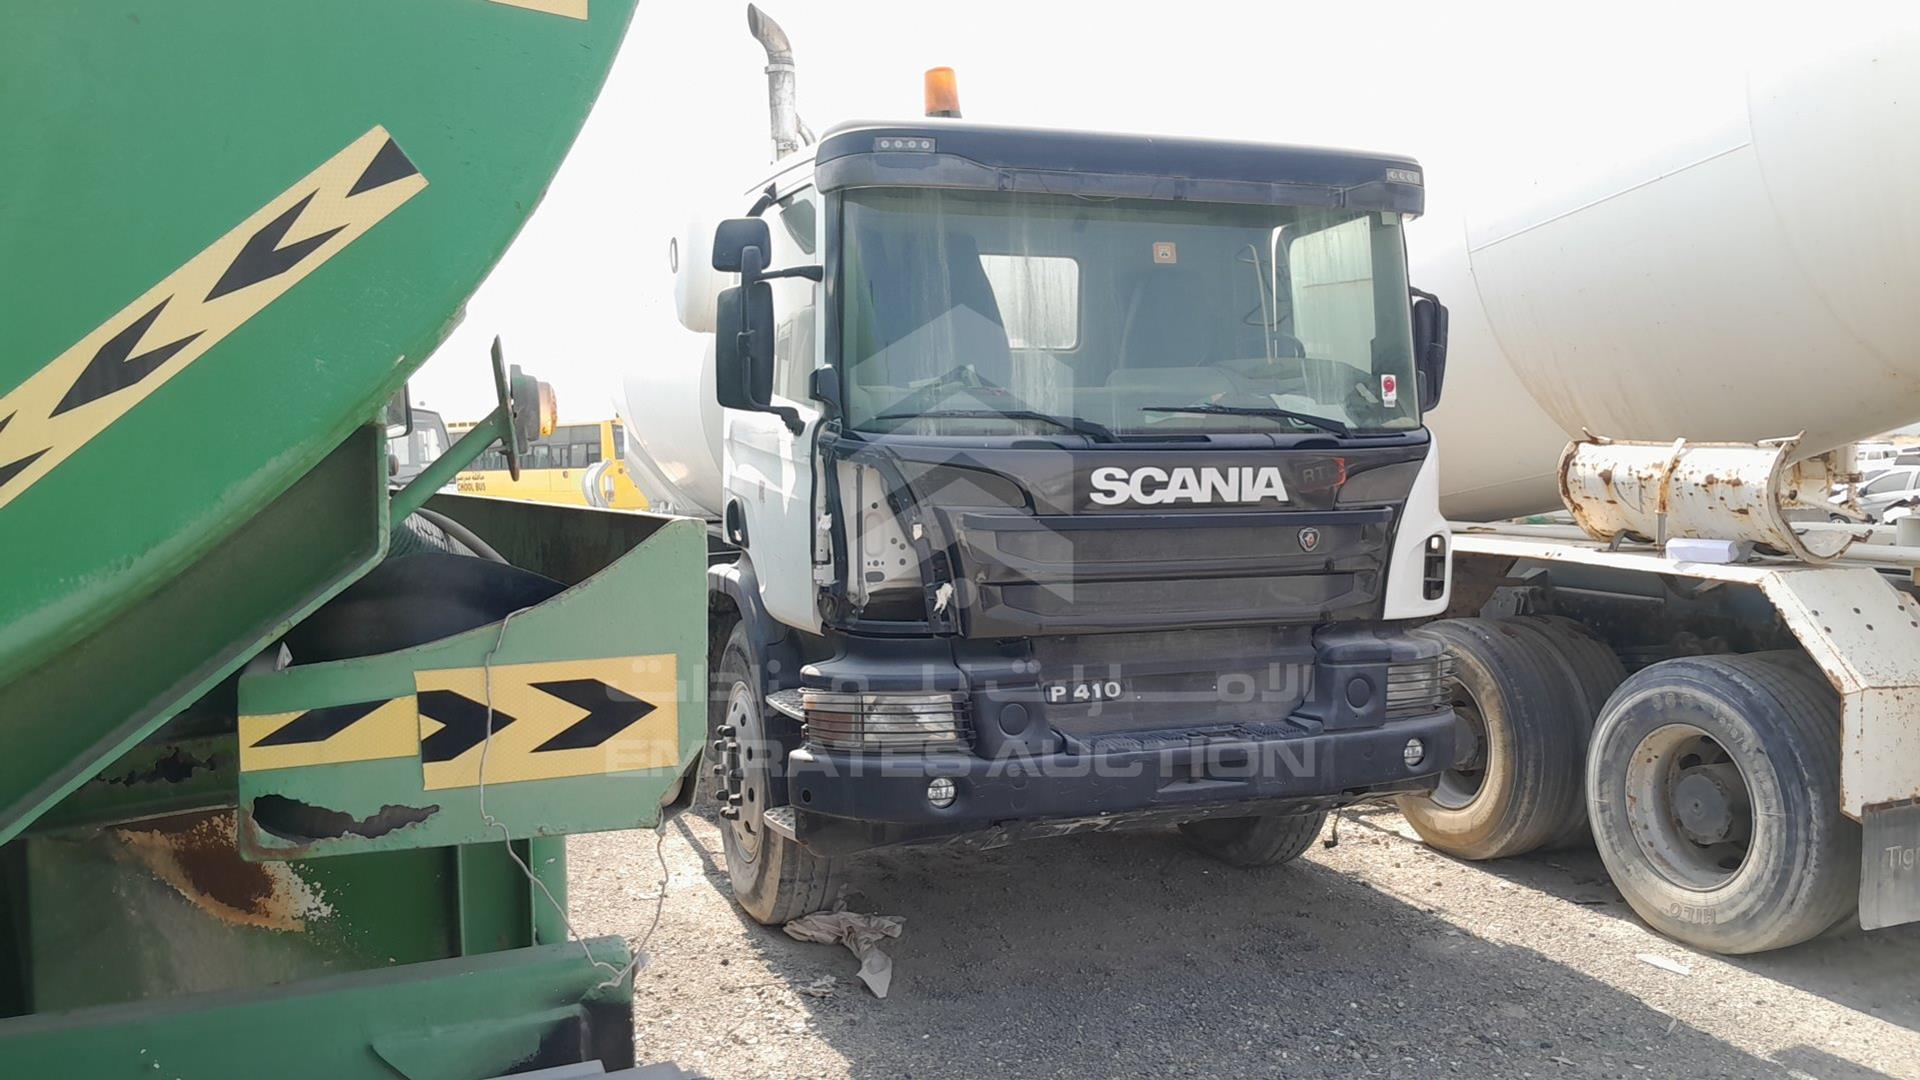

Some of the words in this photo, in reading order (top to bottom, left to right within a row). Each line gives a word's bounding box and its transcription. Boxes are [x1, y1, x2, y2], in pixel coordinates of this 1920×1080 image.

[475, 482, 486, 492] BUS
[1089, 466, 1289, 506] SCANIA
[1049, 685, 1068, 703] P
[1073, 681, 1122, 701] 410
